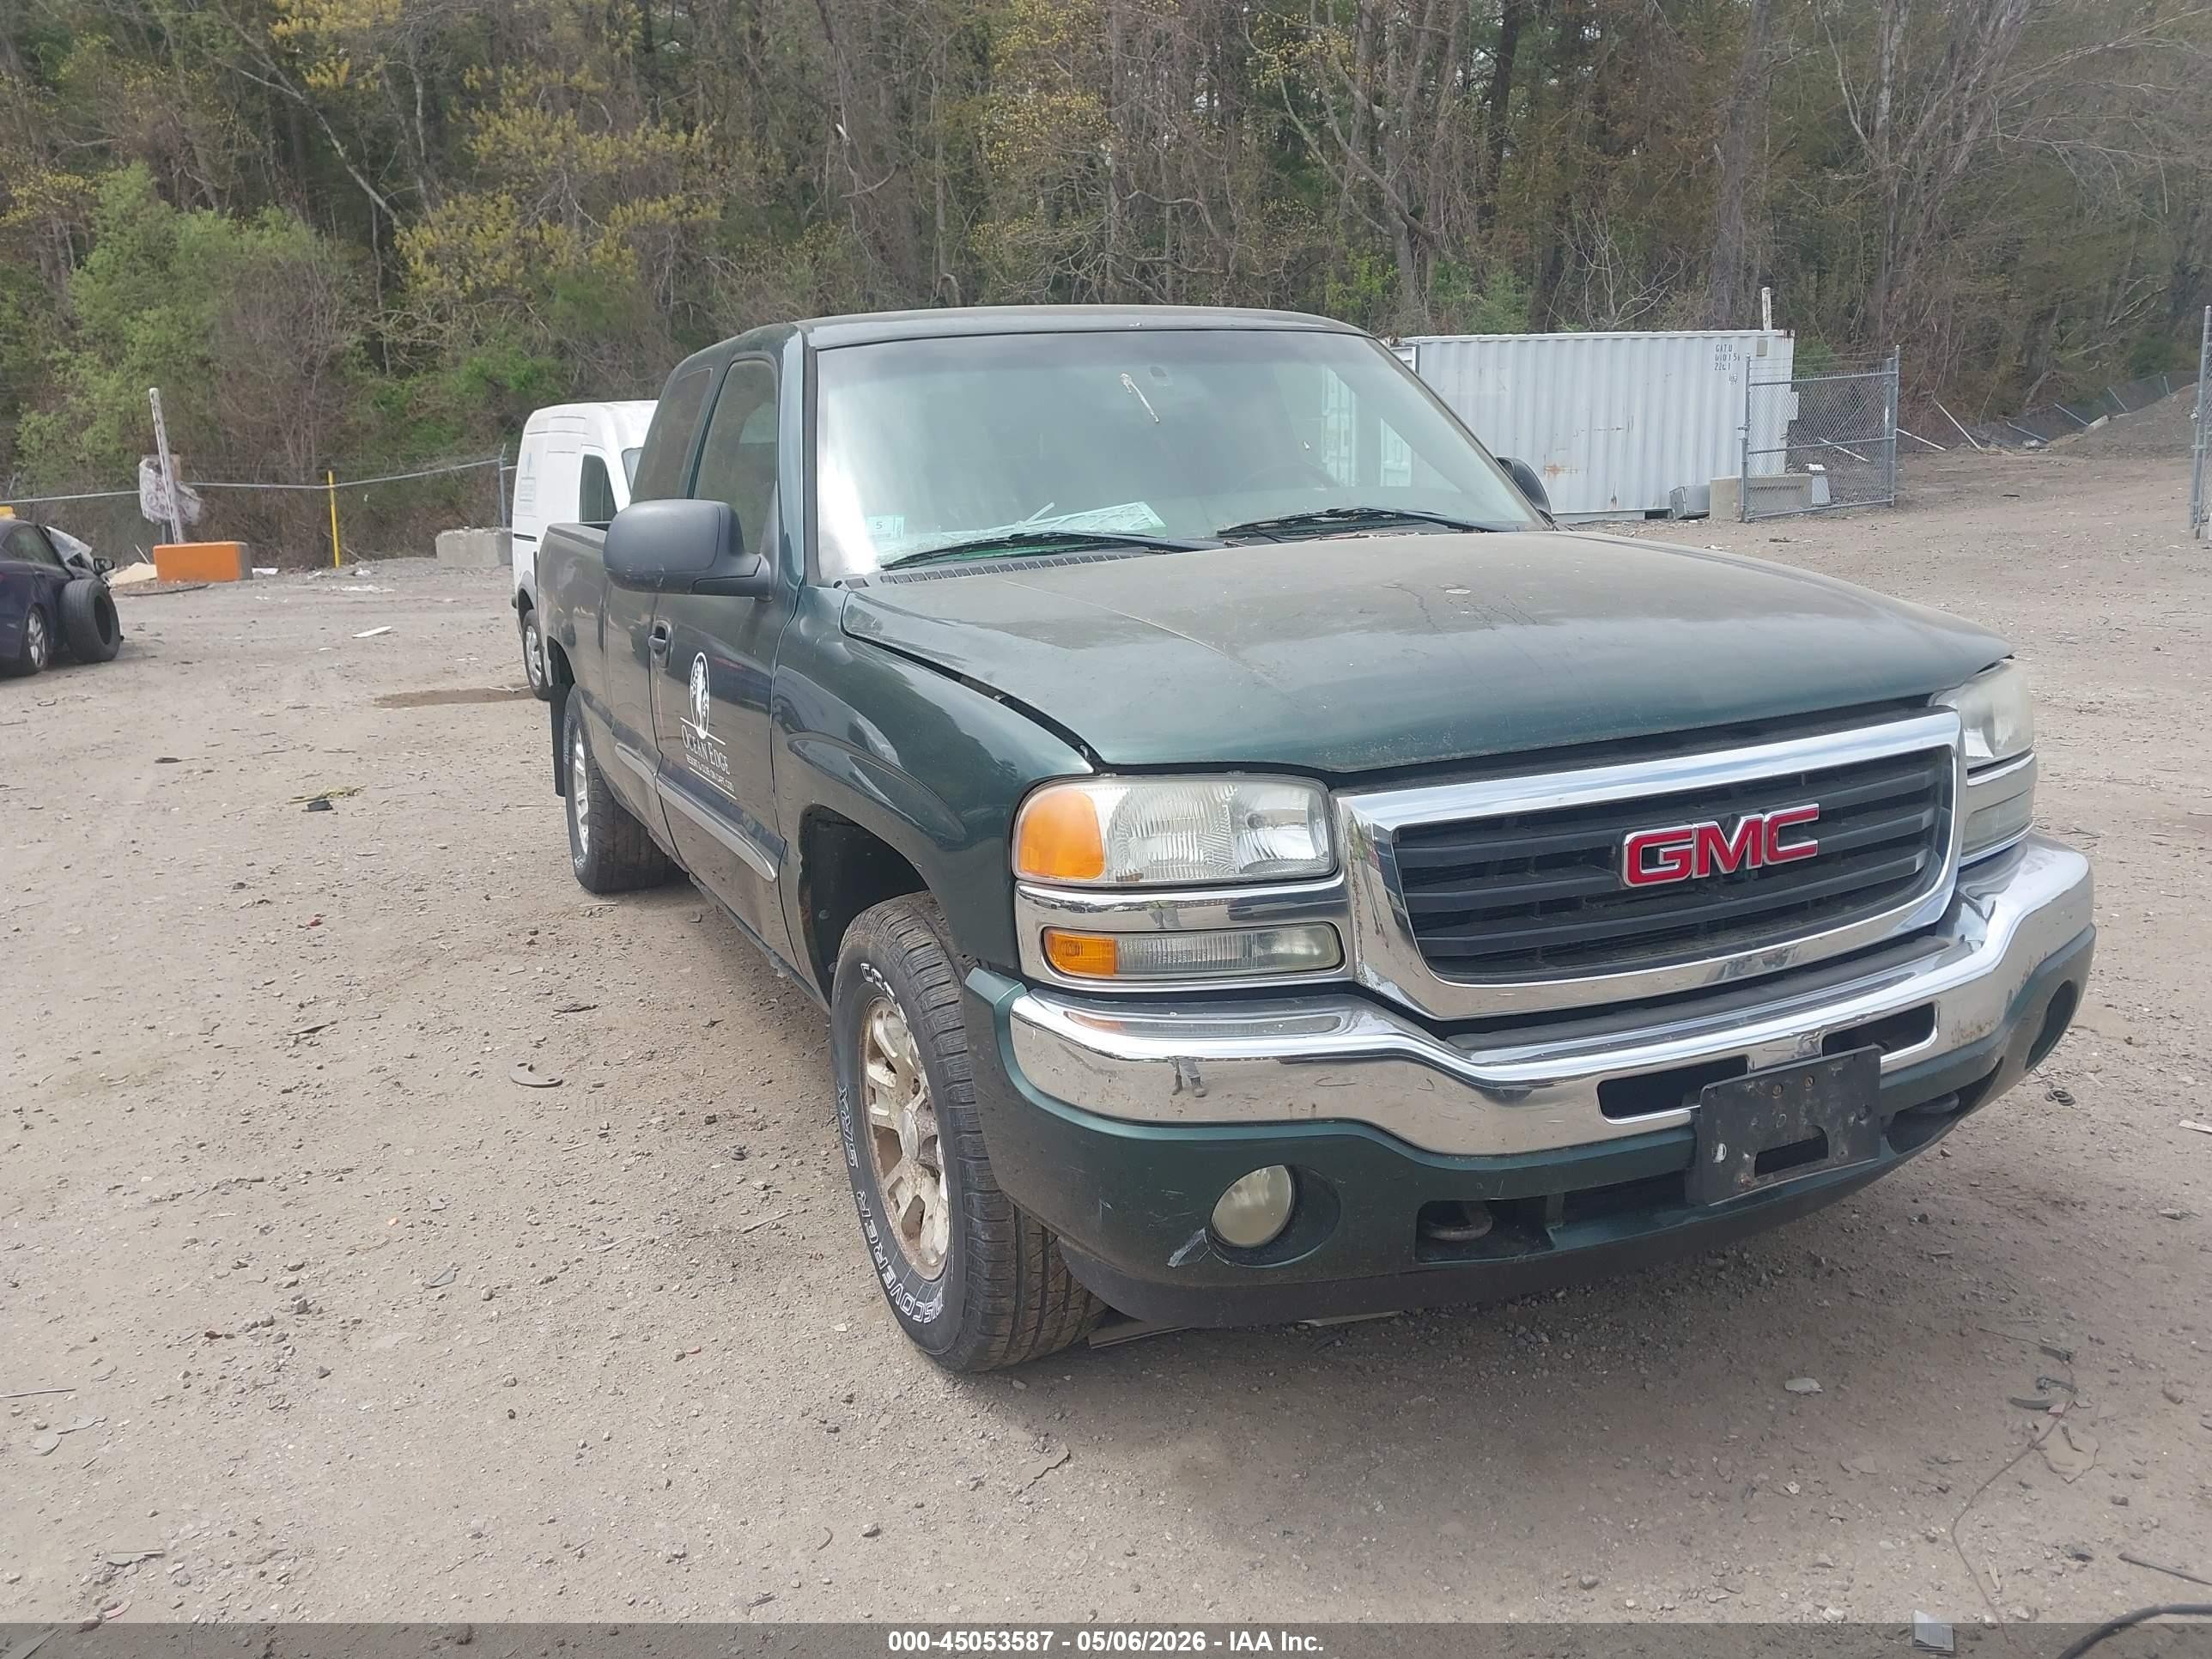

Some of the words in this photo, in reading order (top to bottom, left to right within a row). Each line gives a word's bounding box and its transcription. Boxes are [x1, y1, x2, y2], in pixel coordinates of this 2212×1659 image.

[1715, 343, 1733, 352] GATU
[681, 724, 709, 763] OCEAN
[707, 741, 731, 775] EDGE
[1623, 803, 1820, 888] GMC
[837, 1080, 859, 1169] SRX
[856, 1190, 944, 1324] DISCOVERER
